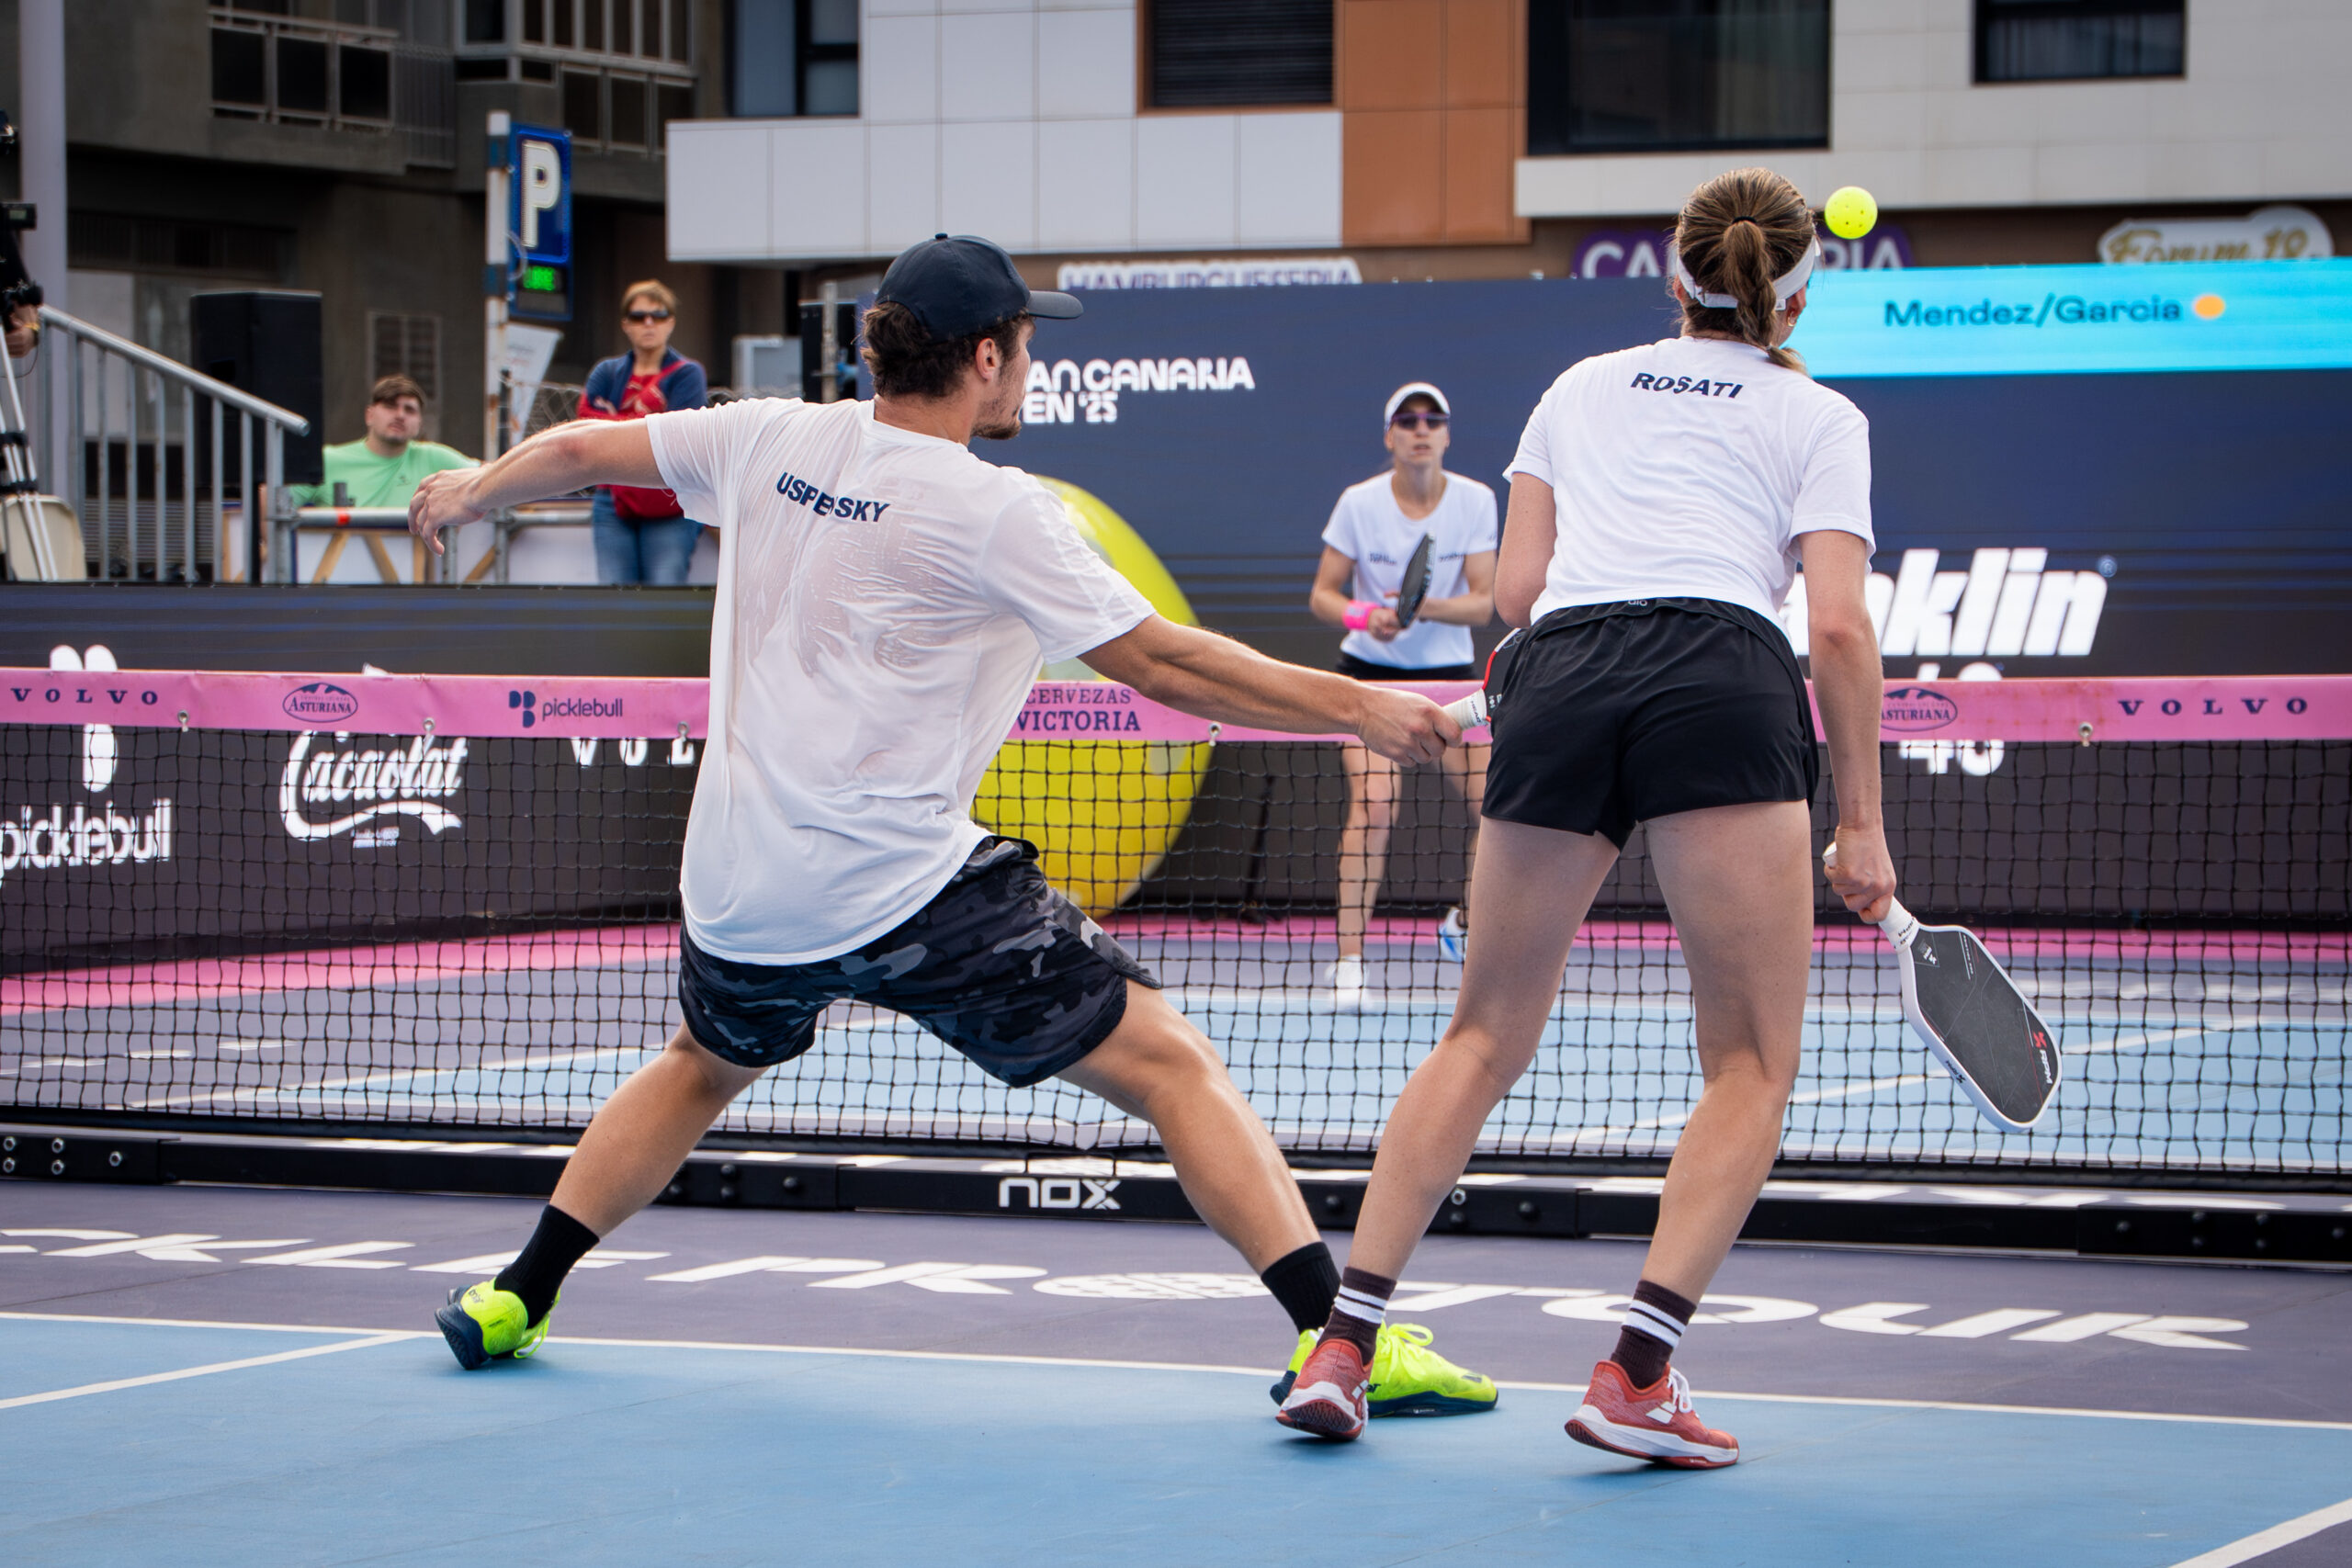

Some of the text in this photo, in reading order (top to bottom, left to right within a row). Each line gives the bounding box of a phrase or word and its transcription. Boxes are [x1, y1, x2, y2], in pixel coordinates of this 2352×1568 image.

[521, 140, 561, 248] P
[1883, 292, 2184, 328] Mendez/Garcia
[1082, 355, 1256, 392] CANARIA
[1630, 372, 1744, 399] ROSATI
[776, 471, 890, 523] USPESKY
[10, 687, 159, 705] VOLVO
[288, 696, 352, 714] ASTURIANA
[542, 697, 623, 722] picklebull
[1025, 688, 1131, 705] CERVEZAS
[2117, 696, 2308, 716] VOLVO
[1017, 710, 1141, 731] VICTORIA
[0, 797, 172, 889] picklebull
[1384, 1280, 2250, 1351] TOUR
